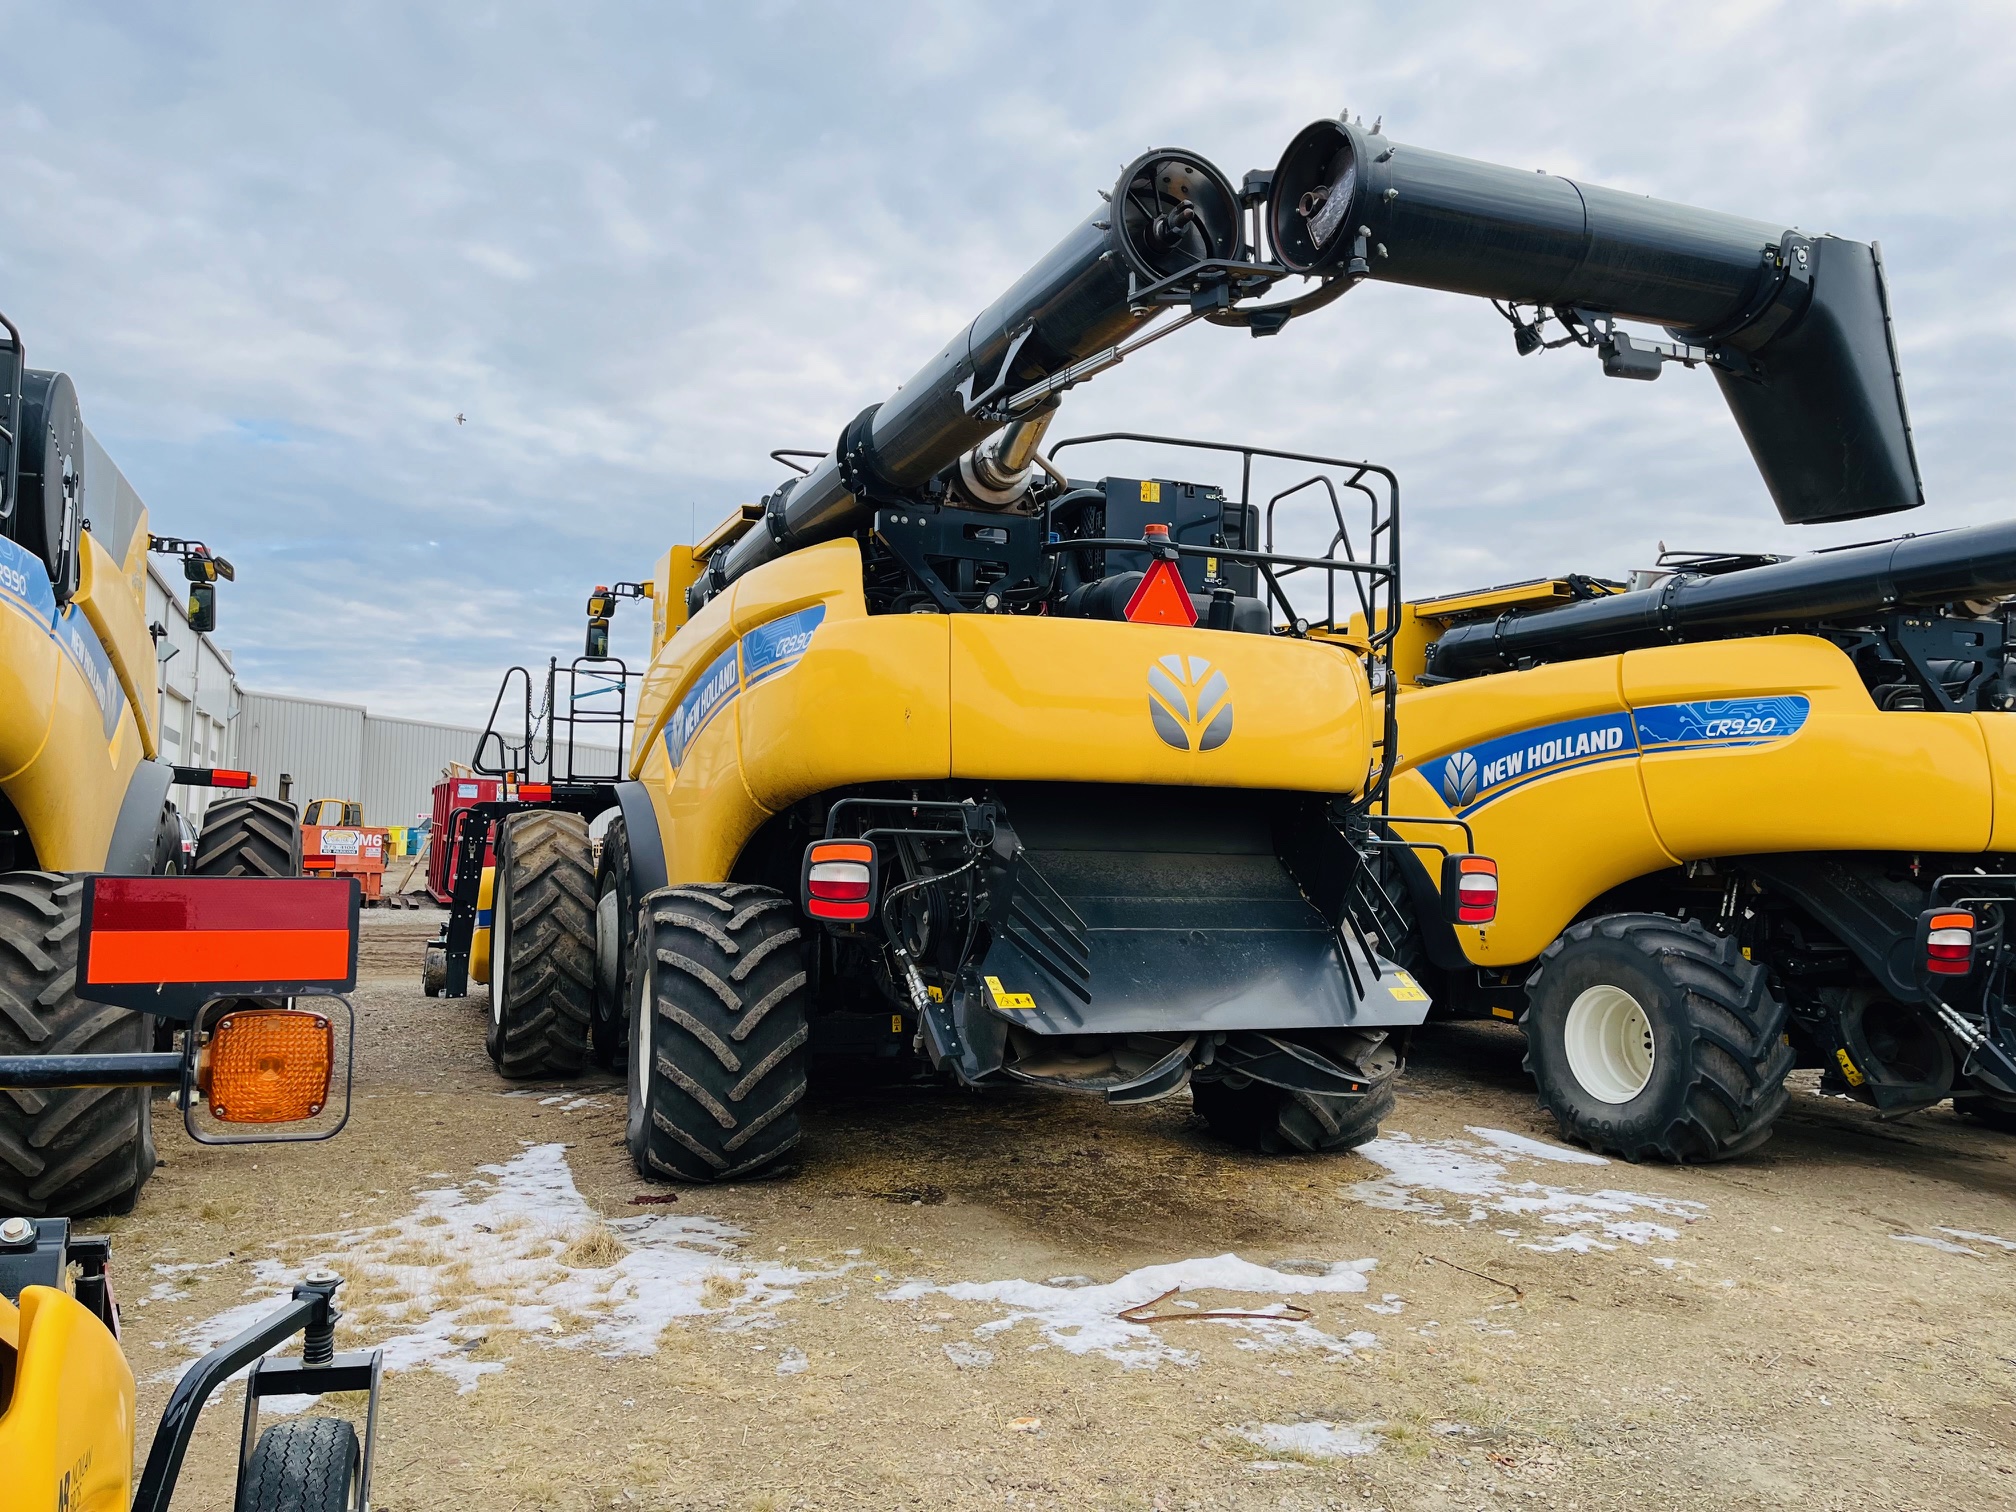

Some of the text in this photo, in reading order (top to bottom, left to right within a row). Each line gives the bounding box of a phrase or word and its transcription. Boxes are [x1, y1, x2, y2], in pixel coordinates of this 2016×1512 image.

[775, 630, 815, 658] CR9.90
[684, 659, 736, 743] NEW HOLLAND
[1706, 717, 1778, 738] CR9.90
[1482, 727, 1624, 788] NEW HOLLAND
[360, 834, 383, 847] M6
